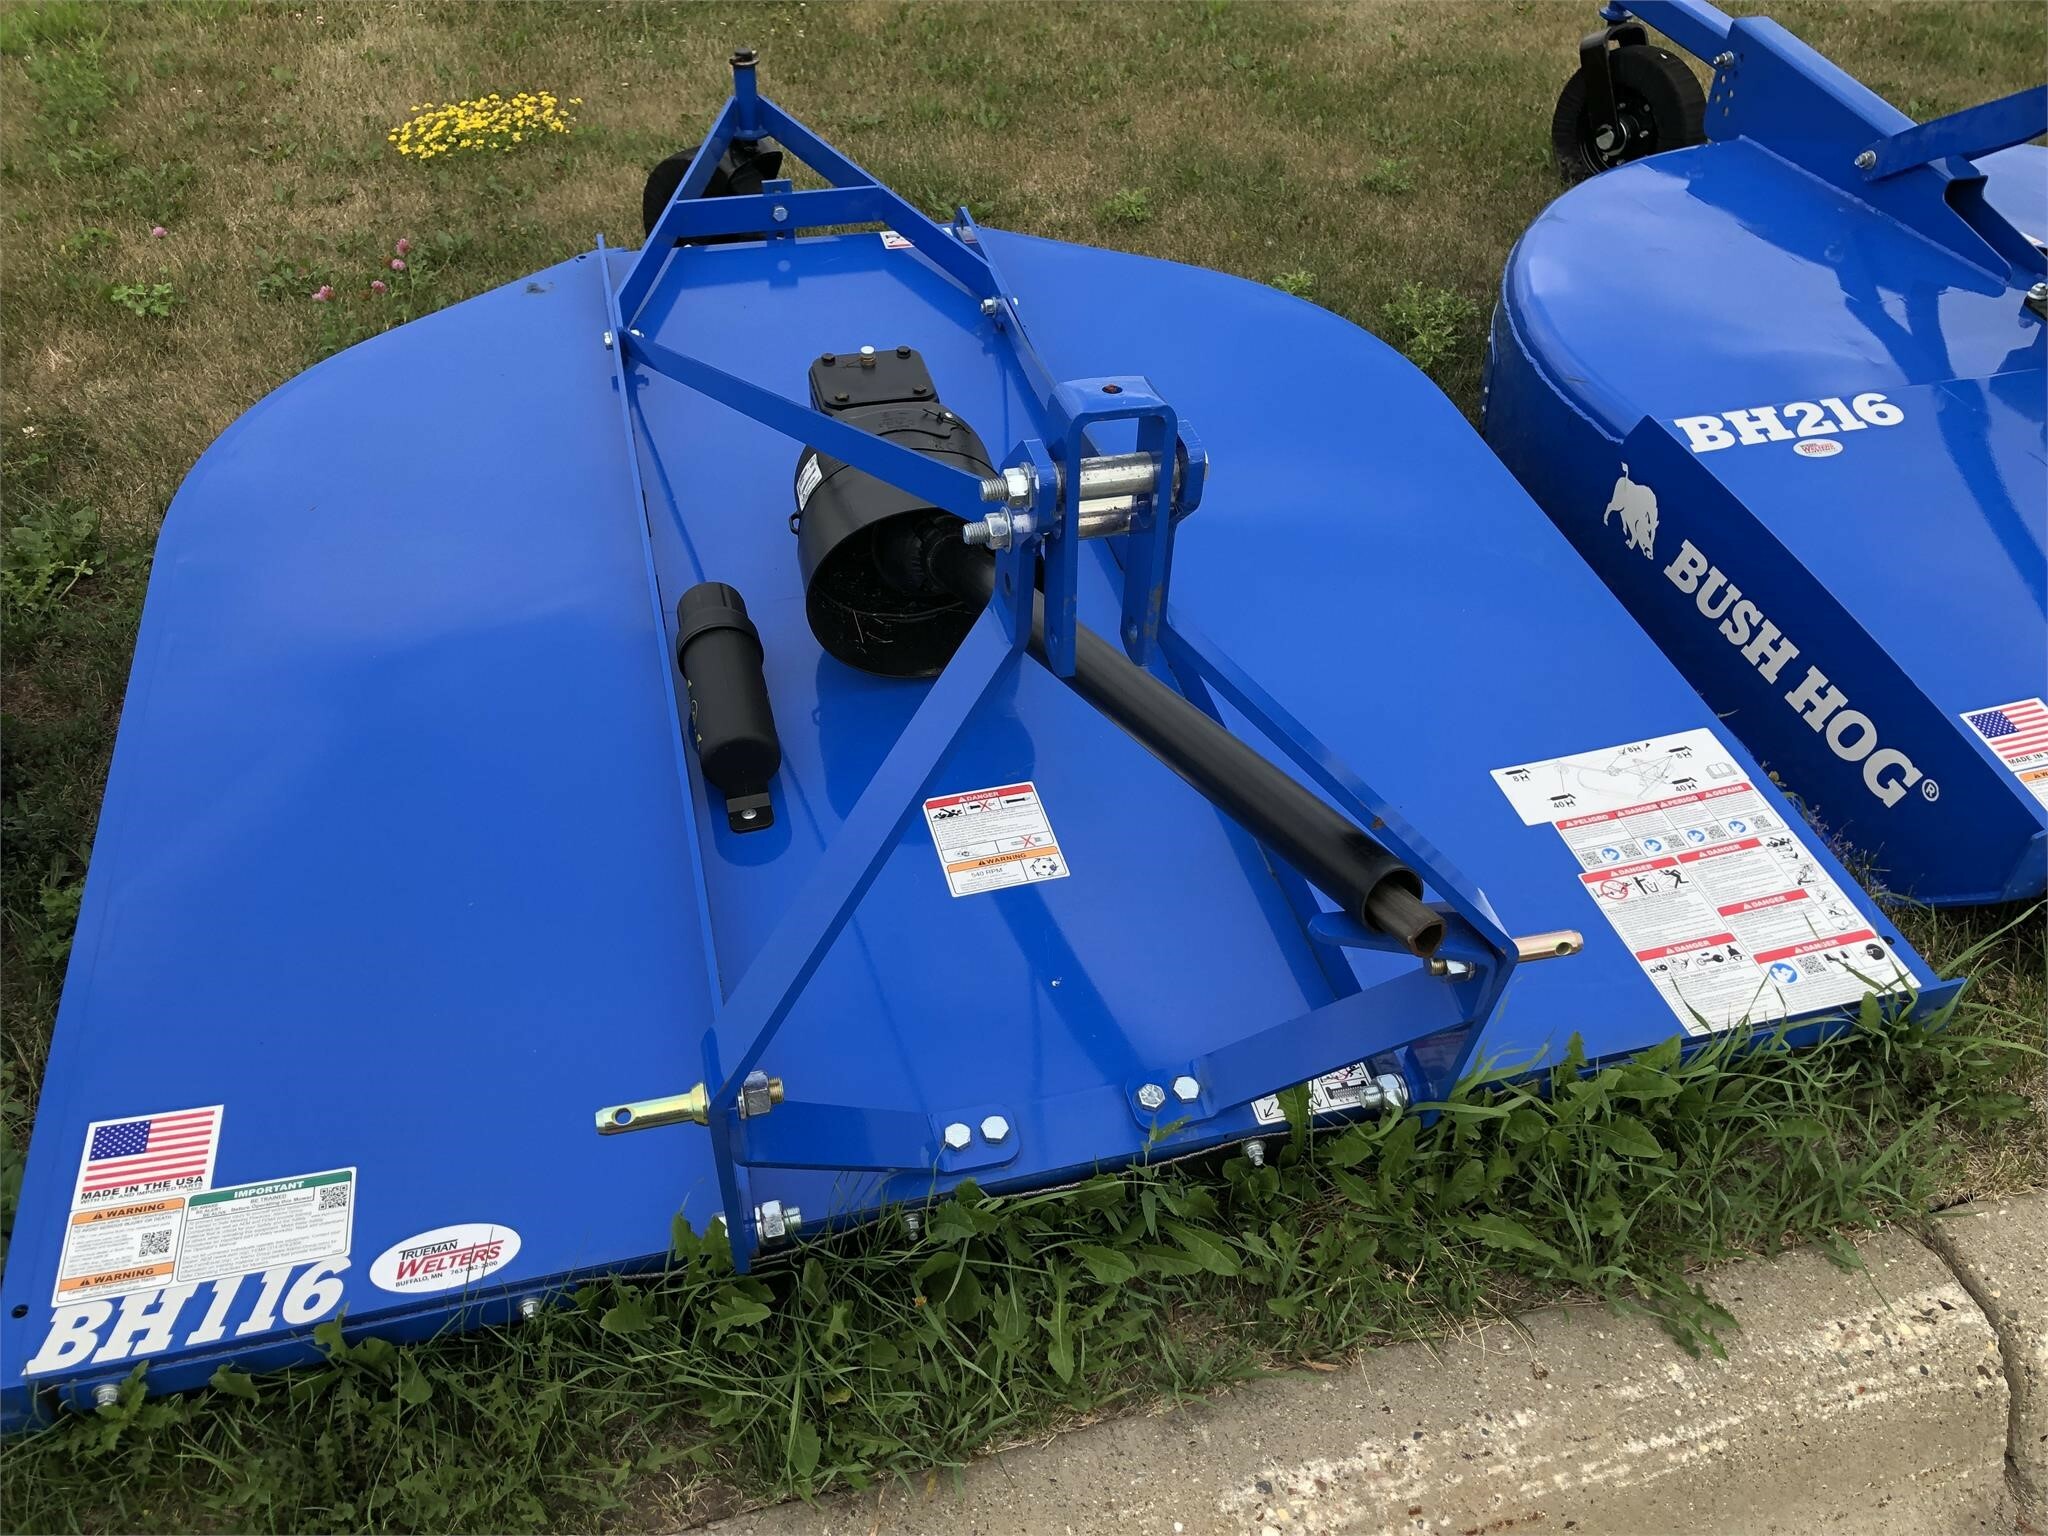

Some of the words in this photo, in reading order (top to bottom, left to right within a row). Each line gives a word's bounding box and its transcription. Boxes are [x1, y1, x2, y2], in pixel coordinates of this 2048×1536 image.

[1673, 392, 1905, 454] BH216
[1663, 539, 1800, 684] BUSH
[2008, 755, 2032, 765] MADE
[966, 791, 999, 801] DANGER
[1713, 785, 1744, 797] GEFAHR
[1667, 795, 1698, 807] PERIGO
[1624, 803, 1659, 815] DANGER
[1574, 814, 1609, 828] PELIGRO
[1707, 844, 1742, 856] DANGER
[987, 853, 1027, 864] WARNING
[1618, 864, 1653, 876] DANGER
[1751, 895, 1787, 908] DANGER
[1674, 940, 1711, 952] DANGER
[80, 1187, 120, 1200] MADE
[125, 1185, 139, 1194] IN
[144, 1180, 171, 1190] THE
[175, 1176, 203, 1186] USA
[233, 1181, 305, 1199] IMPORTANT
[106, 1203, 165, 1219] WARNING
[398, 1239, 458, 1261] TRUEMAN
[396, 1242, 503, 1281] WELTERS
[94, 1268, 154, 1284] WARNING
[395, 1275, 430, 1288] BUFFALO,
[20, 1255, 352, 1376] BH116
